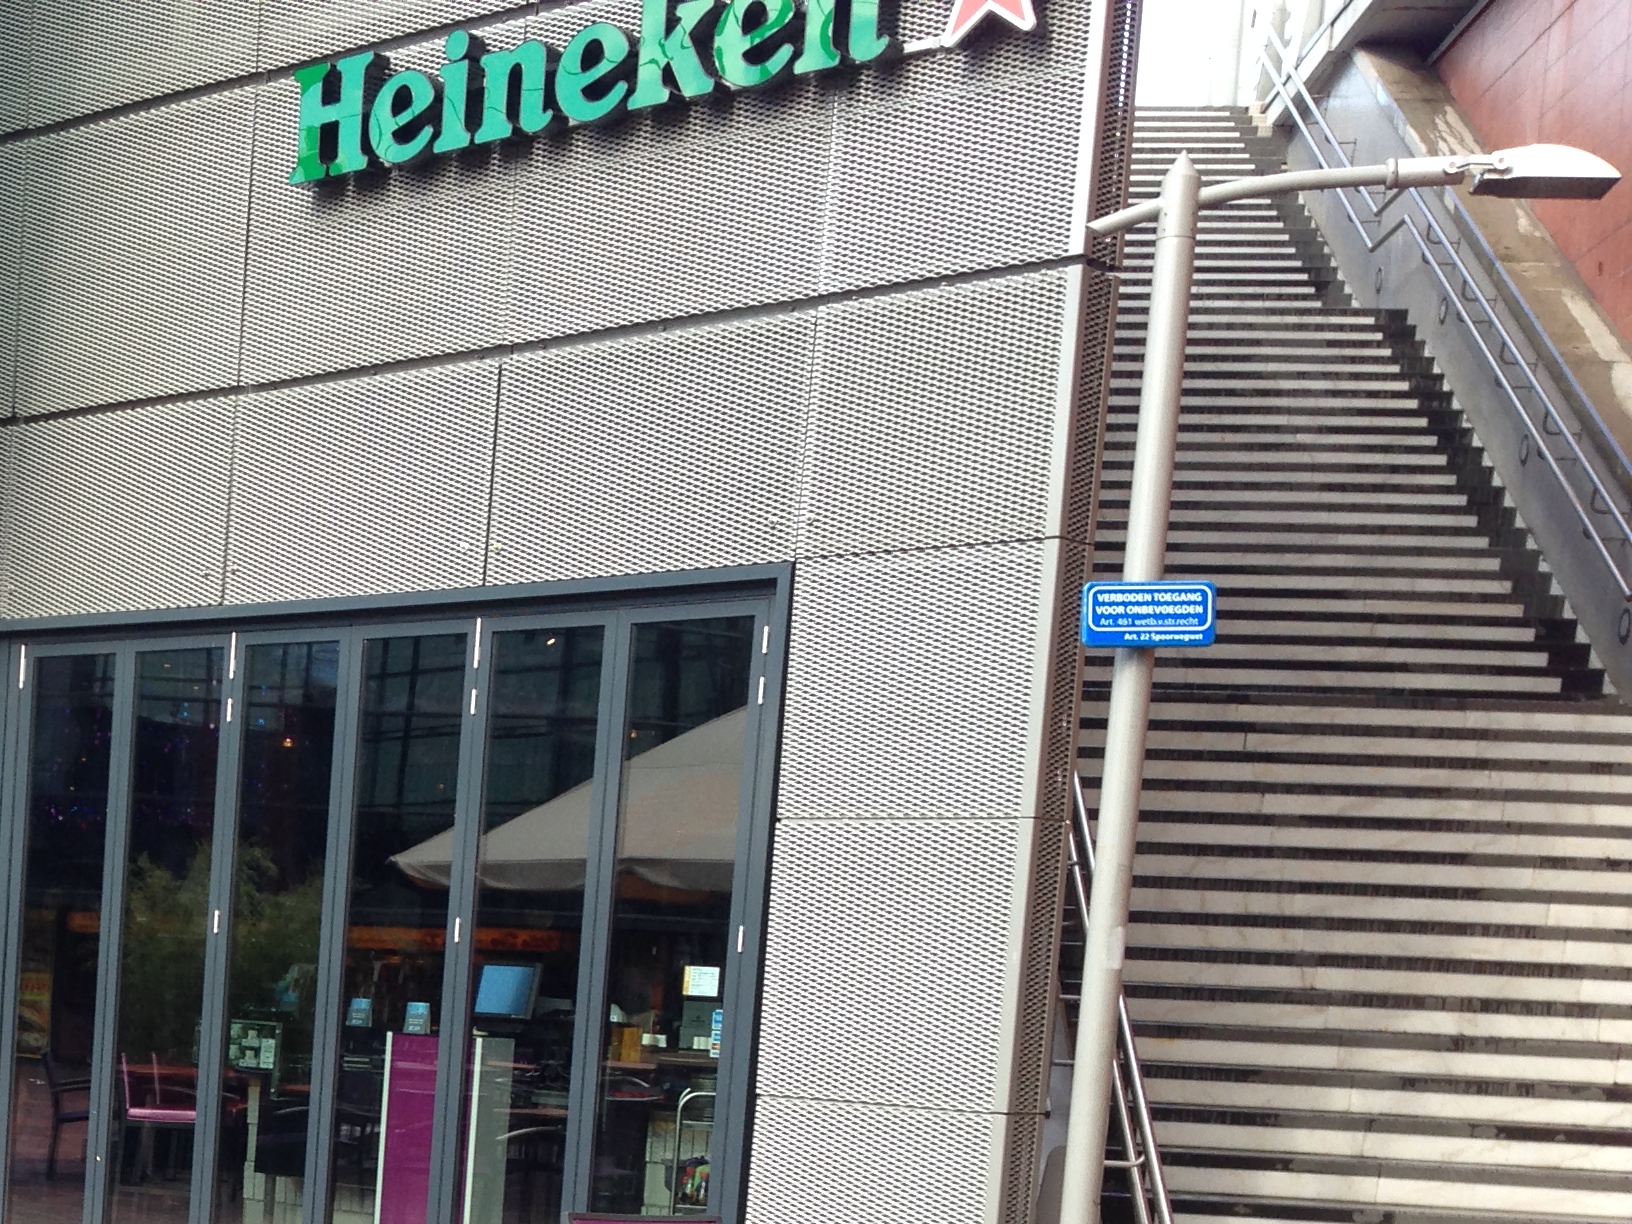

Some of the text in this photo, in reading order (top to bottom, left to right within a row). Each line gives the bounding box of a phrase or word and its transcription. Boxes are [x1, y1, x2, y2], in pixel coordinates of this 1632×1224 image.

[289, 0, 889, 185] Heineken
[1096, 591, 1203, 603] VERBODEN TOEGANG
[1095, 604, 1204, 615] VOOR ONBEVOEGDEN
